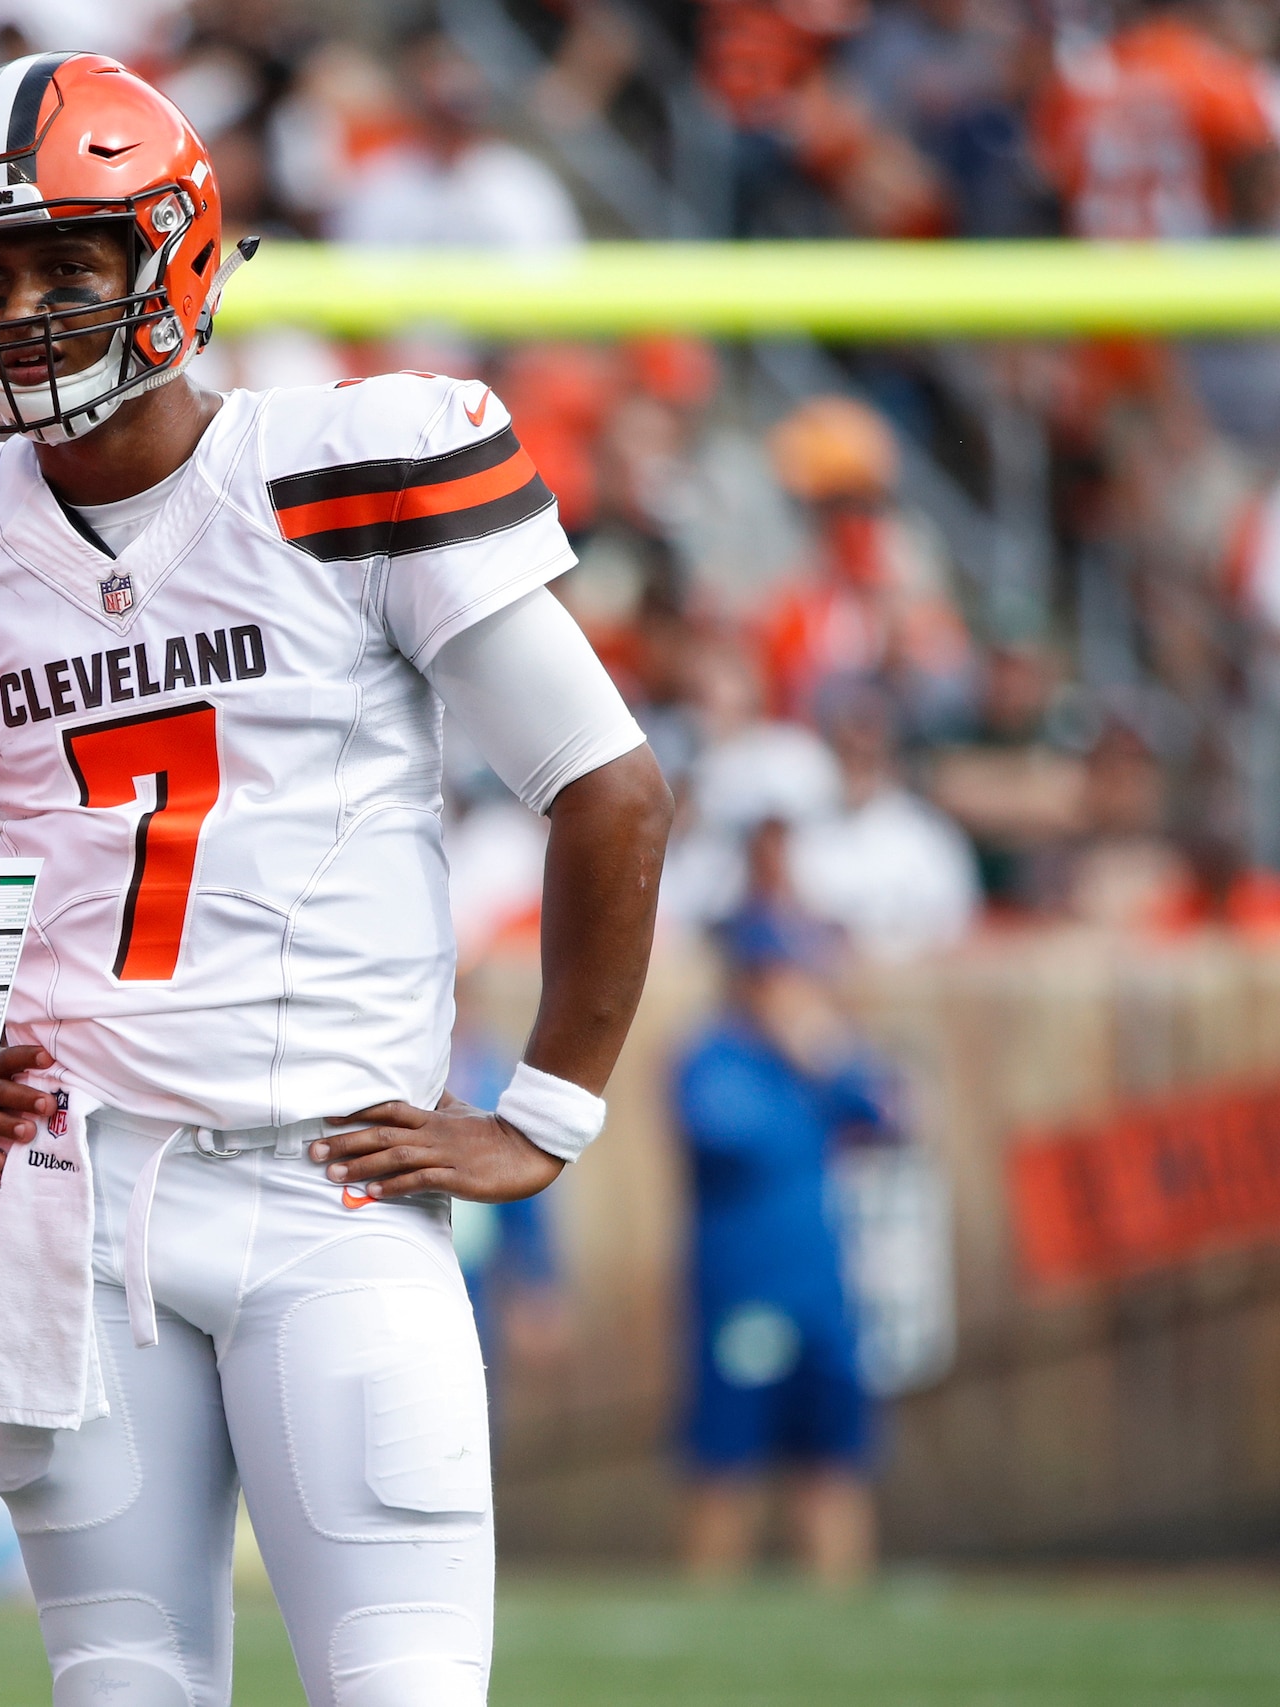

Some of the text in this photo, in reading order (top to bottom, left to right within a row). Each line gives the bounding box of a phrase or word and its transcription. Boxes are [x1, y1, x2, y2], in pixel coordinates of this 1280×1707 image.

[105, 590, 132, 611] NFL
[0, 624, 267, 728] CLEVELAND
[60, 699, 221, 982] 7
[28, 1150, 77, 1173] Wilson
